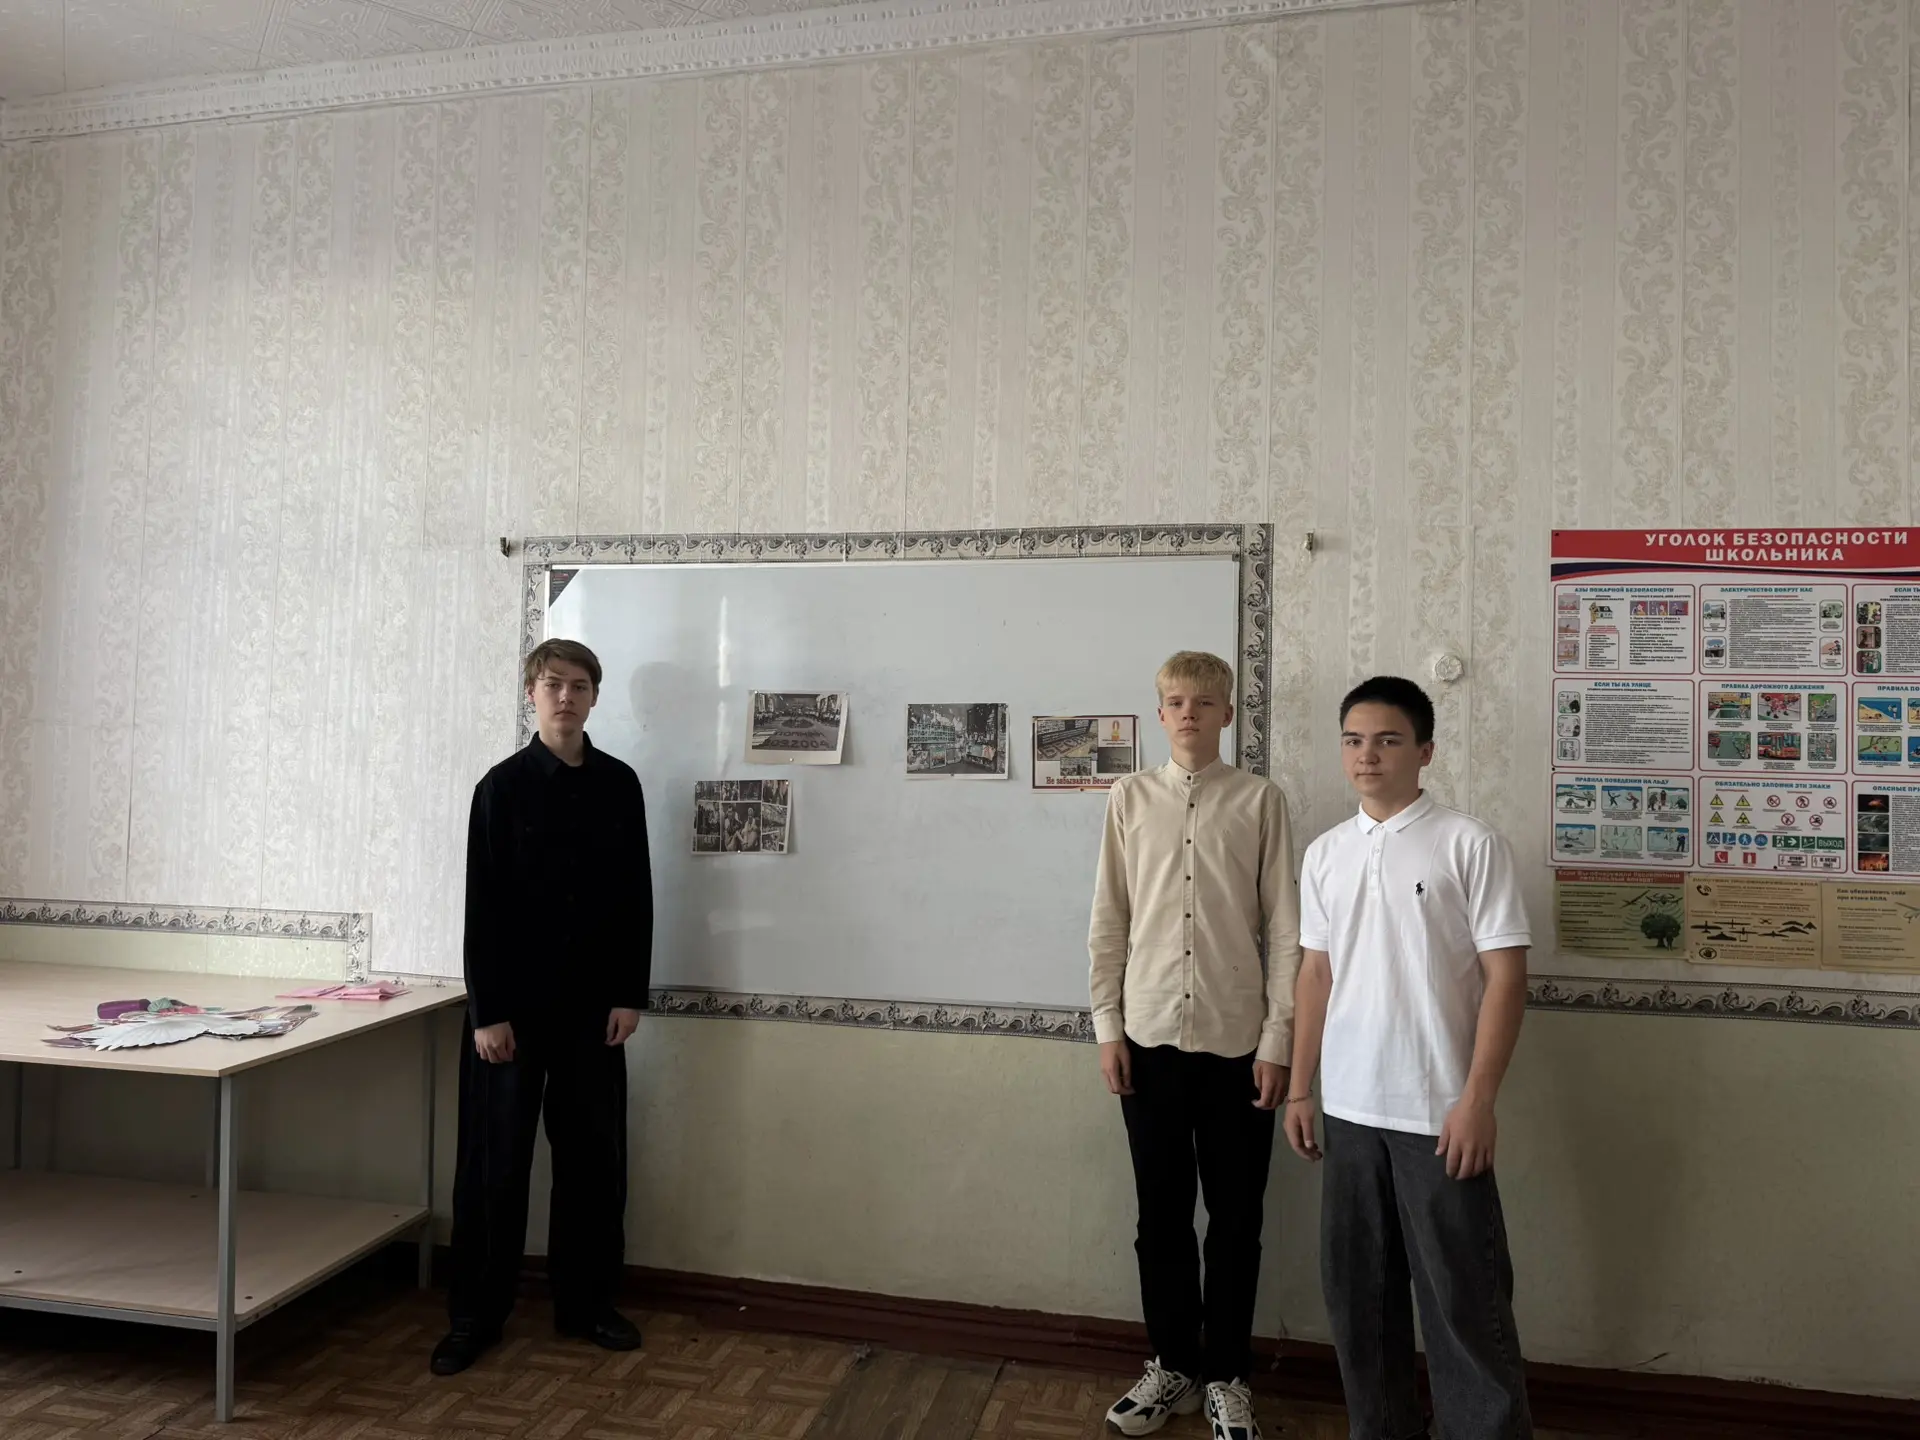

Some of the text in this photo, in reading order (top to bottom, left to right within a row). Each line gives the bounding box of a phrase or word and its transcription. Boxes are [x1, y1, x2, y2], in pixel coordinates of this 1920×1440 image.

[1645, 531, 1908, 546] УГОЛОК БЕЗОПАСНОСТИ
[1705, 548, 1844, 561] ШКОЛЬНИКА
[1046, 776, 1055, 784] Не
[1056, 776, 1091, 784] забывайте
[1819, 840, 1844, 848] ВЫХОД
